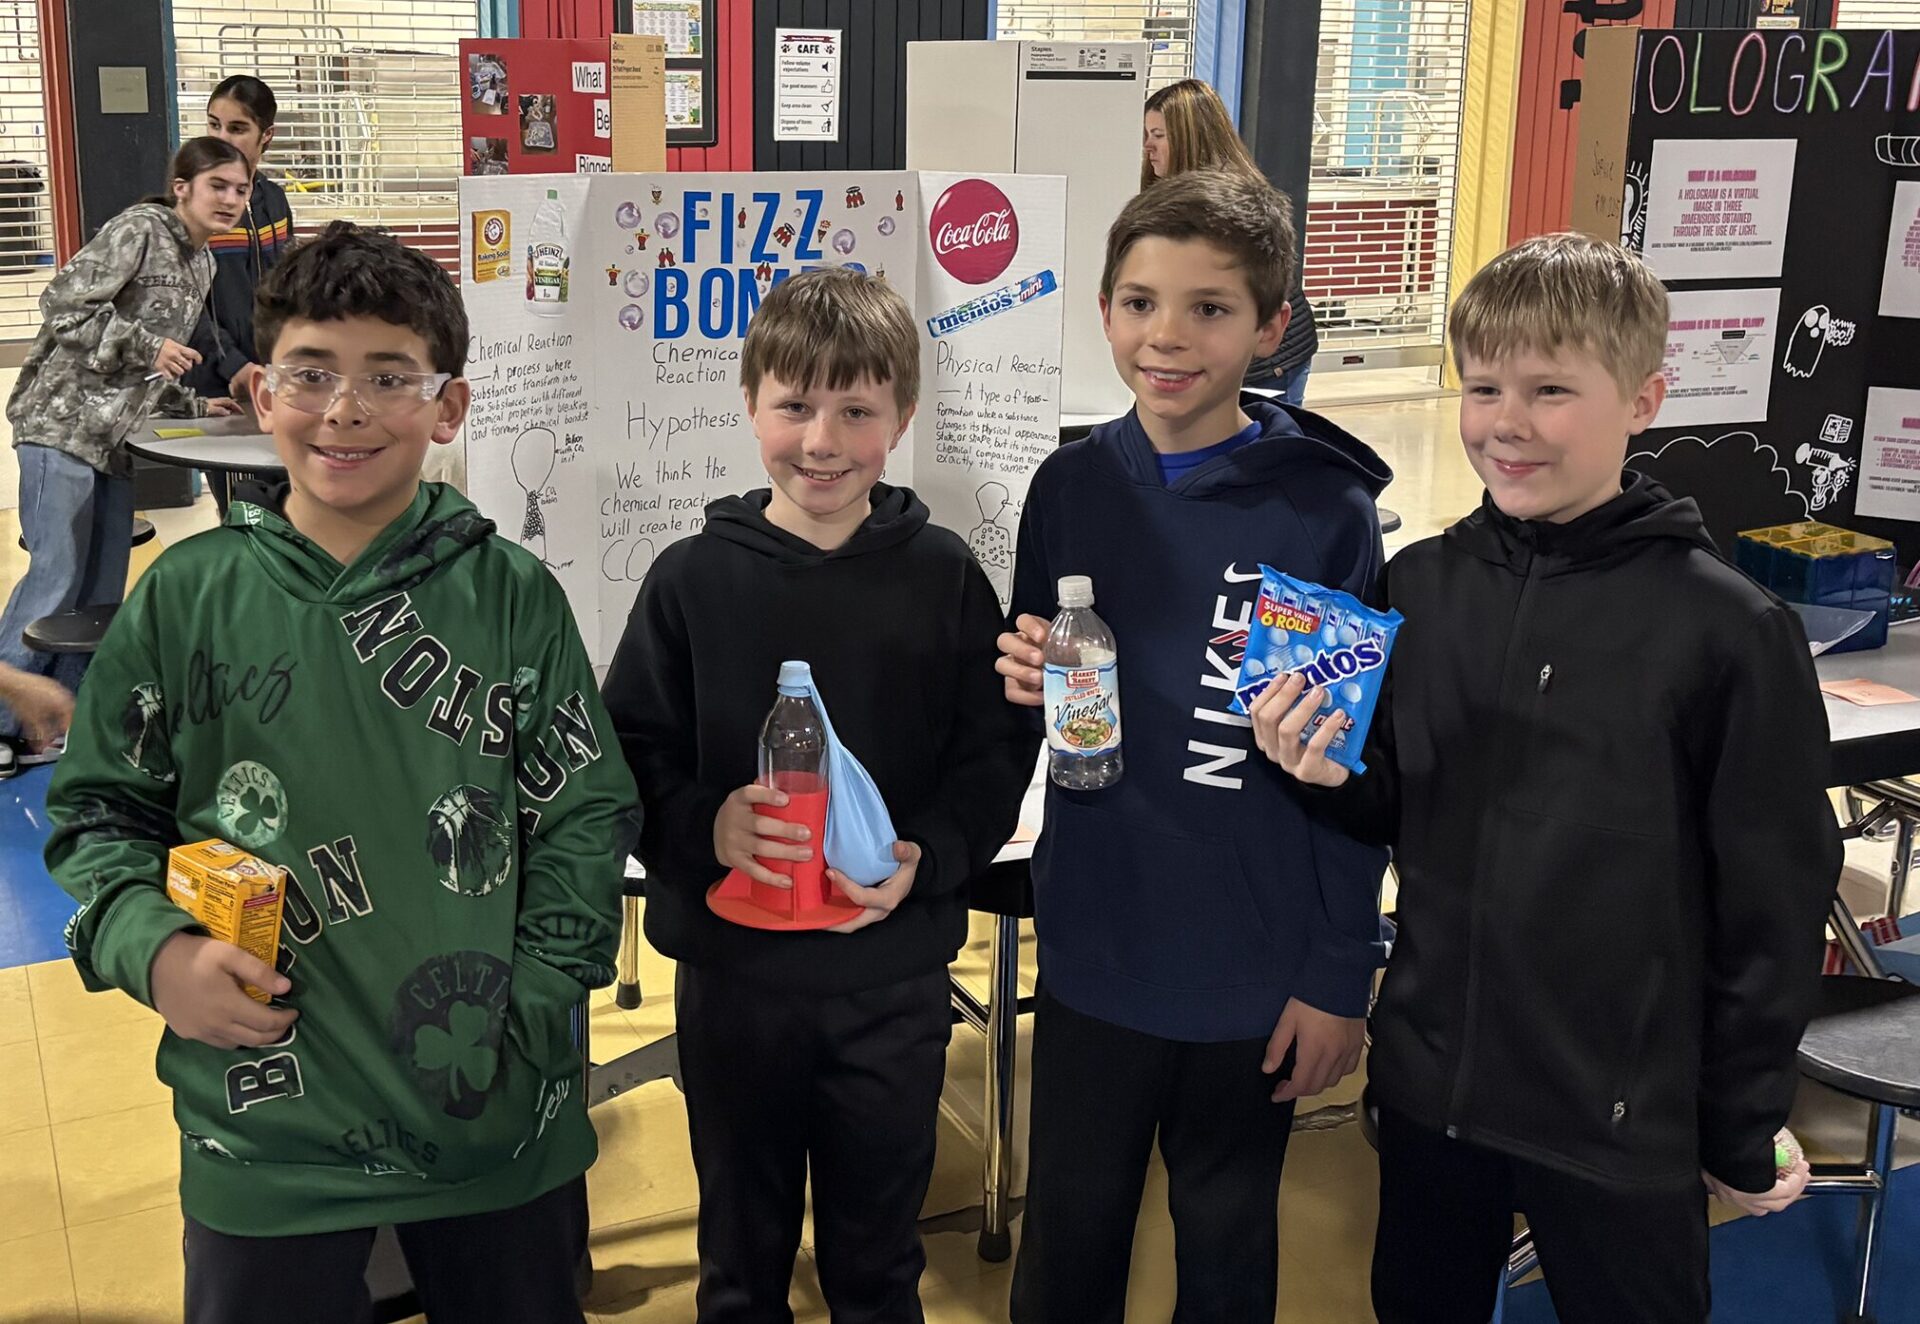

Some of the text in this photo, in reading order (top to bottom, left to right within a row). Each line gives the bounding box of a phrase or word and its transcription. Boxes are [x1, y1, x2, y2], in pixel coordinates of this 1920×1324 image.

[797, 44, 820, 54] CAFE
[575, 66, 602, 89] What
[1632, 30, 1920, 116] OLOGRA
[597, 108, 610, 130] Be
[1678, 188, 1759, 200] A HOLOGRAM IS A VIRTUAL
[1693, 200, 1742, 212] IMAGE IN THREE
[683, 189, 824, 264] FIZZ
[1673, 224, 1758, 237] THROUGH THE USE OF LIGHT.
[1681, 213, 1752, 225] DIMENSIONS OBTAINED
[497, 250, 510, 258] Soda
[539, 247, 560, 257] HEINZ
[654, 262, 867, 339] BOM
[1020, 278, 1043, 302] mint
[937, 292, 1013, 331] mentos
[1667, 321, 1696, 331] OLOGRAM
[467, 332, 573, 363] Chemical Reaction
[652, 342, 738, 364] Chemica
[937, 340, 1061, 377] Physical Reaction
[493, 359, 572, 382] A process where
[656, 362, 726, 384] Reaction
[470, 374, 577, 402] Substances transform into
[531, 391, 549, 404] with
[965, 381, 972, 400] A
[979, 382, 1000, 406] type
[1004, 388, 1021, 404] of
[936, 402, 974, 417] formation
[471, 427, 487, 441] and
[627, 401, 741, 451] Hypothesis
[969, 421, 980, 431] its
[1015, 429, 1057, 442] appearance
[994, 438, 1008, 449] but
[1010, 441, 1020, 450] its
[936, 455, 974, 473] exactly
[979, 459, 994, 471] the
[975, 449, 1024, 463] composition
[616, 456, 726, 489] We think the
[668, 492, 710, 511] reacti
[639, 515, 682, 534] create
[1260, 611, 1312, 634] 6 ROLLS
[1264, 601, 1314, 624] SUPER VALUE!
[339, 591, 514, 759] STON
[1236, 639, 1384, 713] mntos
[171, 648, 298, 734] eltics
[1183, 594, 1253, 790] NIKE
[1054, 692, 1113, 723] Vinegar
[221, 766, 269, 819] CELTICS
[409, 961, 511, 1018] CELTI
[342, 1118, 440, 1165] ELTICS
